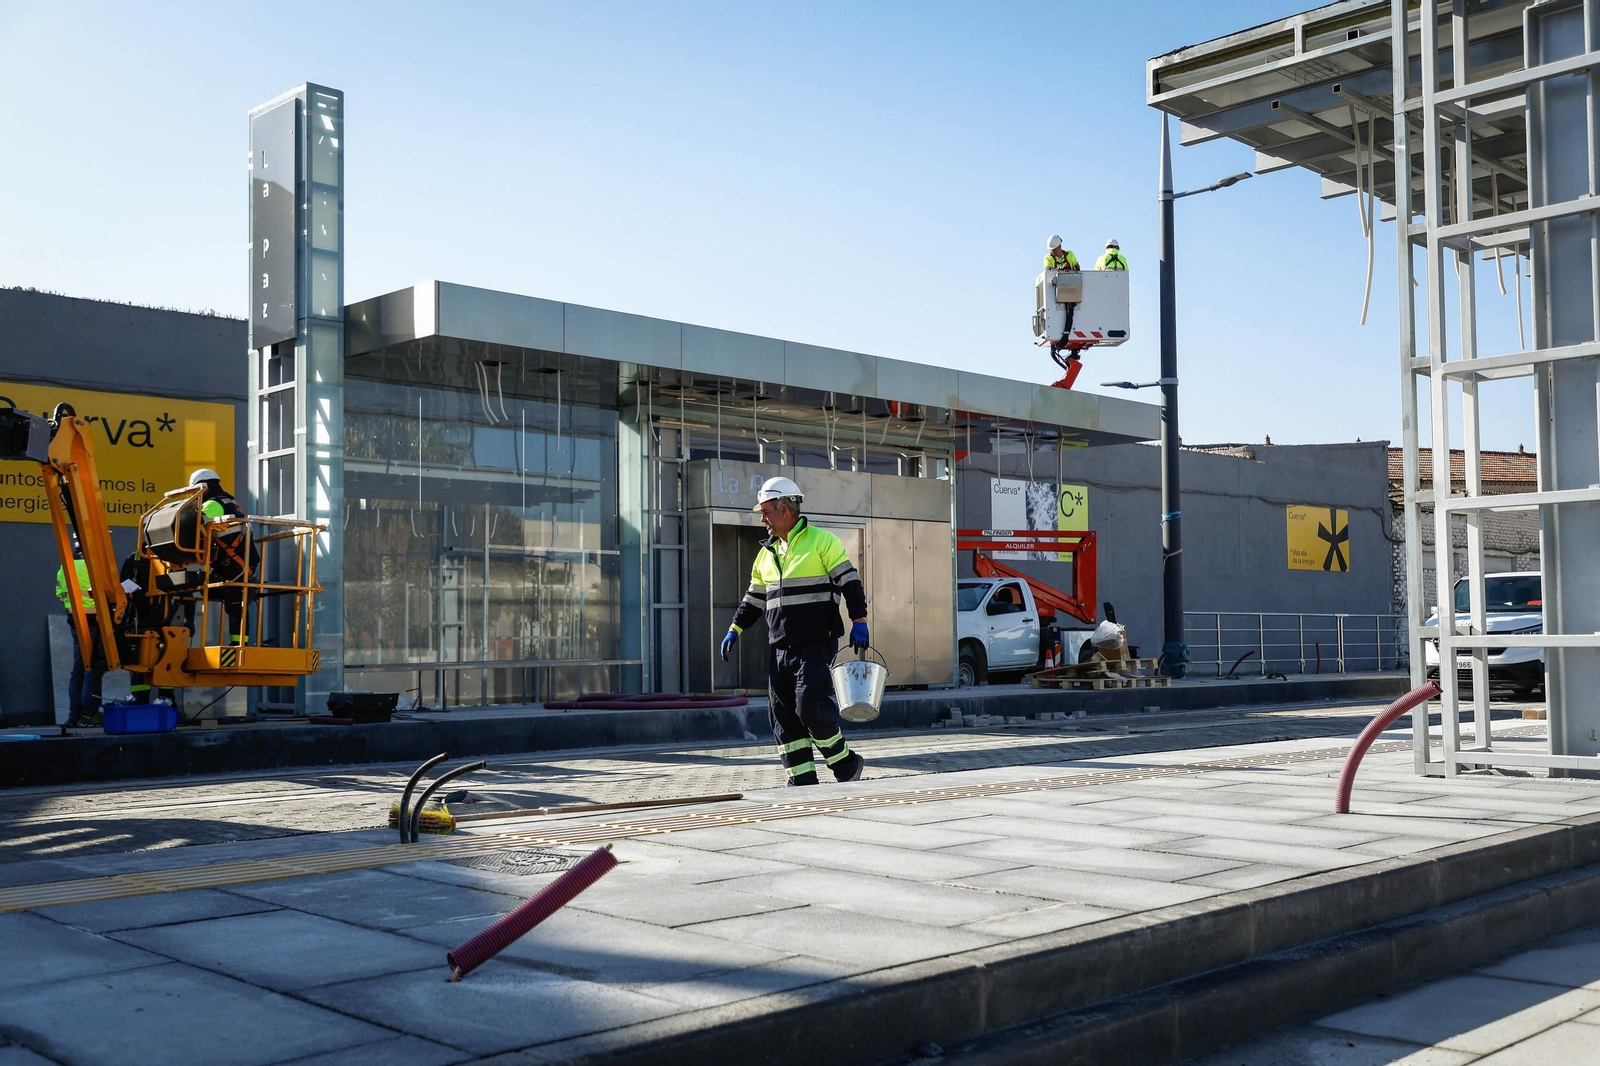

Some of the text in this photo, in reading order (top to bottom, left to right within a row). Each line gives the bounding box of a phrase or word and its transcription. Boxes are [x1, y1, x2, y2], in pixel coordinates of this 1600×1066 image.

[261, 150, 270, 318] La Paz
[0, 472, 45, 488] ntos
[141, 478, 156, 492] la
[719, 470, 739, 493] La
